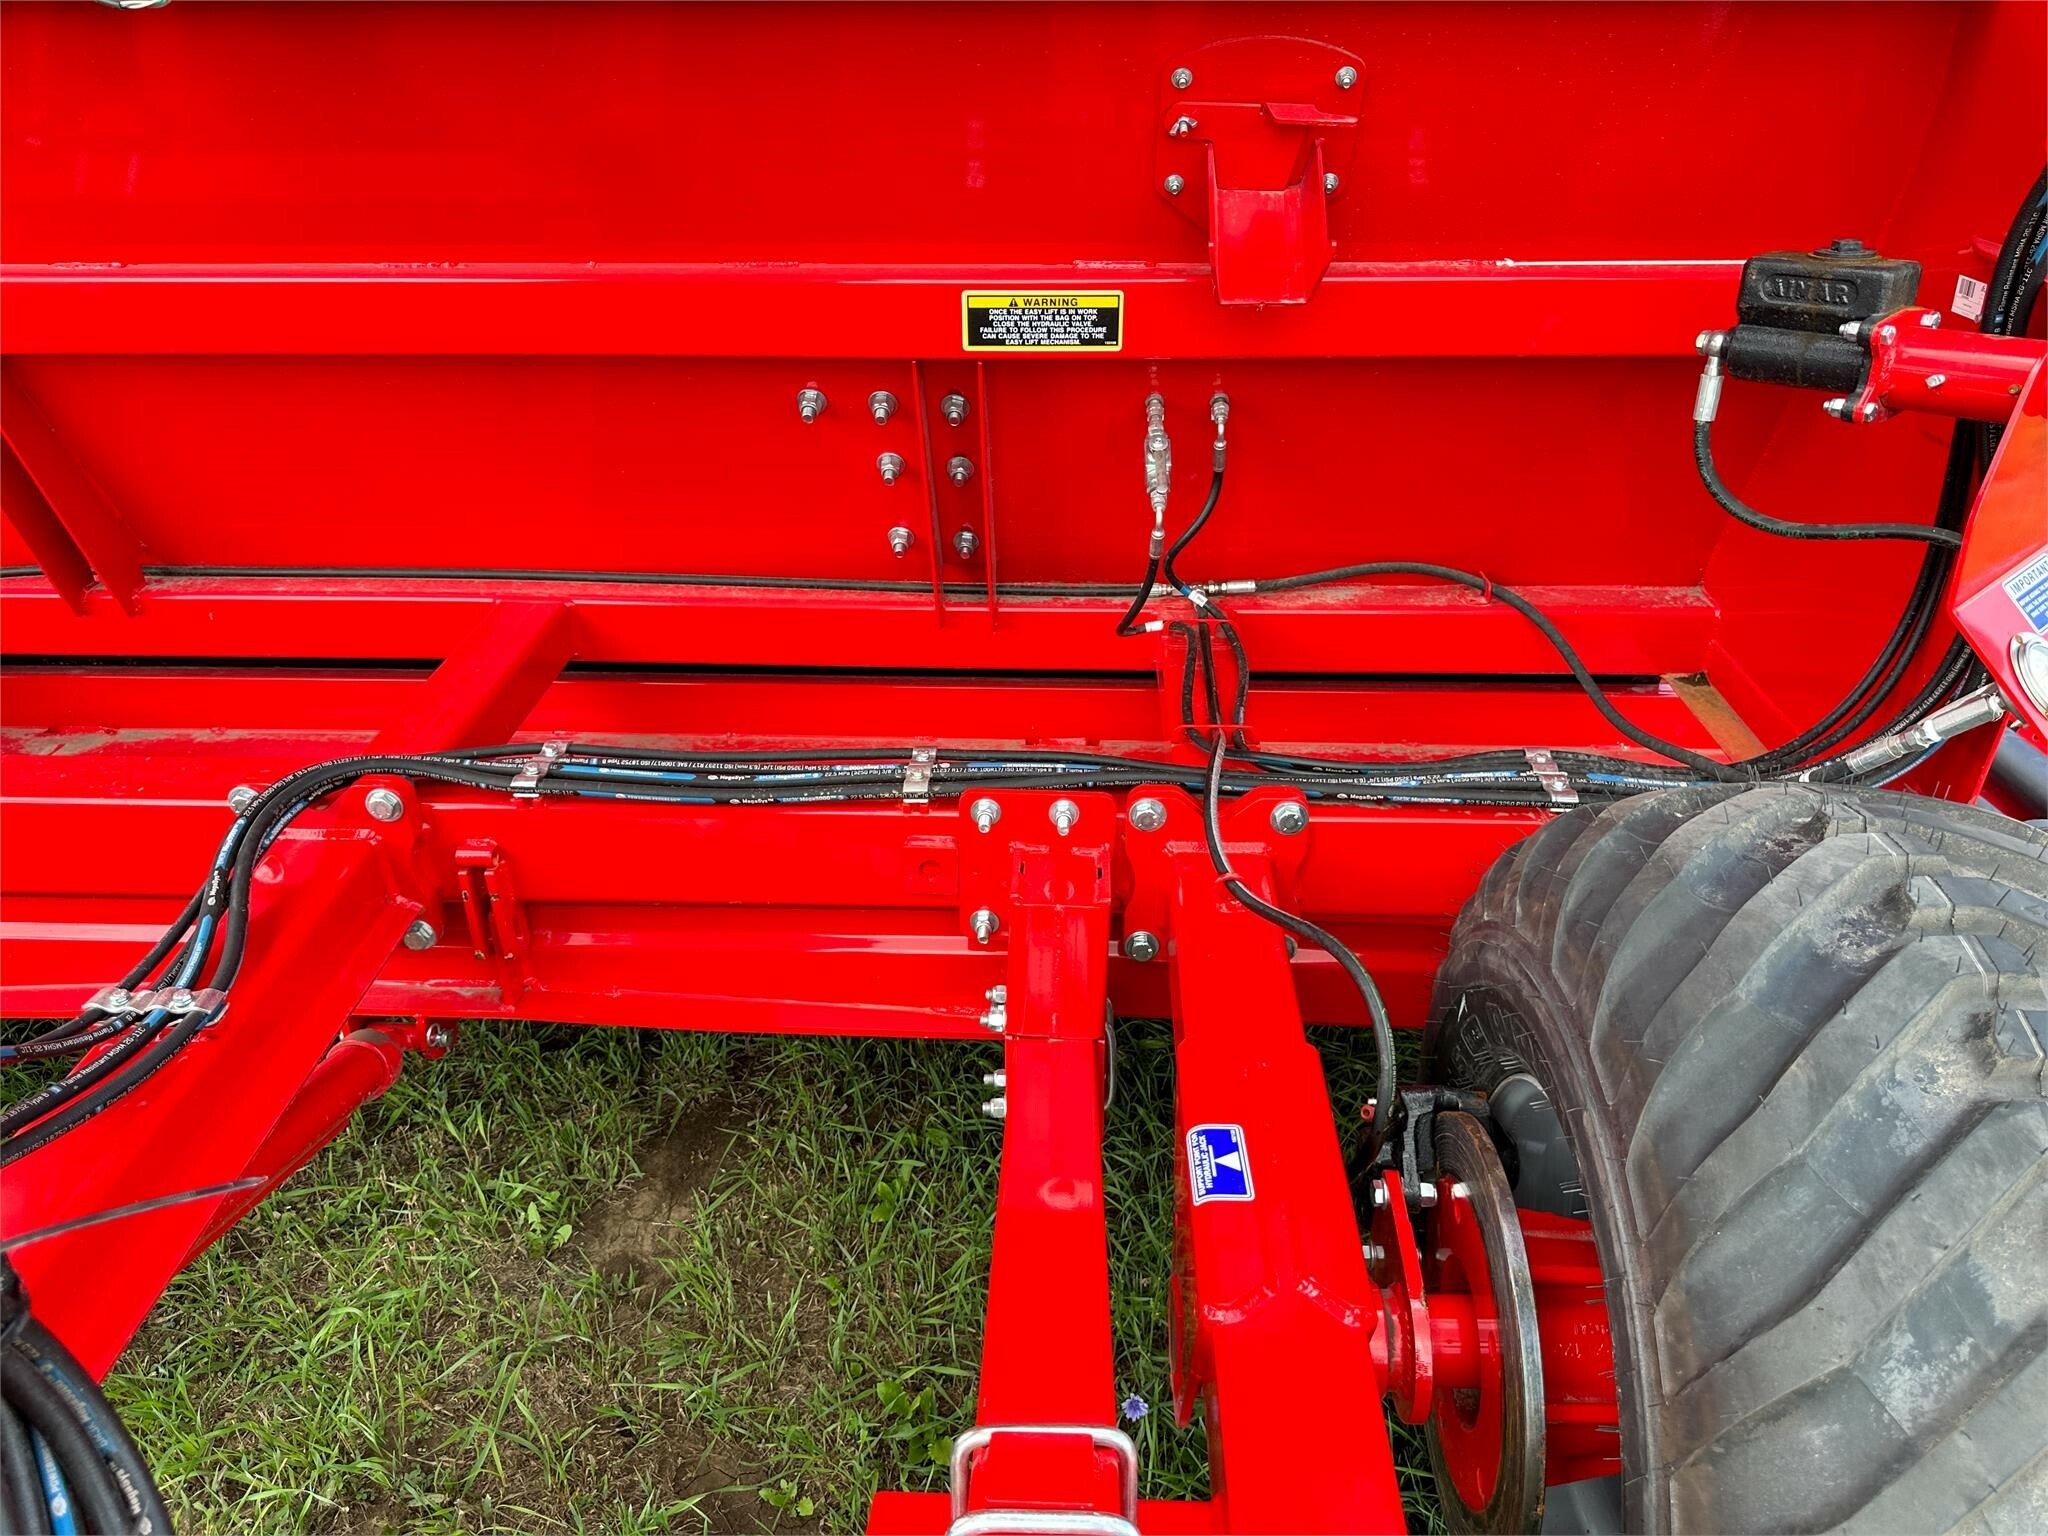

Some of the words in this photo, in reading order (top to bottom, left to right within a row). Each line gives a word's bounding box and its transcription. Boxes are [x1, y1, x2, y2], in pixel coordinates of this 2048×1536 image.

[2010, 296, 2020, 316] MSHA
[2017, 268, 2032, 296] 2G-11C
[1023, 298, 1078, 306] WARNING
[2010, 560, 2048, 596] IMPORTANT
[62, 1033, 94, 1047] Resistant
[94, 1025, 114, 1038] Flame
[20, 1044, 44, 1054] 2G-11C
[44, 1041, 64, 1051] MSHA
[8, 1104, 30, 1118] 18752
[30, 1095, 44, 1107] Type
[61, 1073, 82, 1087] Flame
[80, 1055, 110, 1076] Resistant
[107, 1042, 127, 1058] MSHA
[123, 1027, 146, 1046] 2G-11C
[1199, 1135, 1207, 1151] JACK
[1193, 1147, 1201, 1165] POINT
[1201, 1151, 1213, 1188] HYDRAULIC
[1196, 1166, 1206, 1195] SUPPORT
